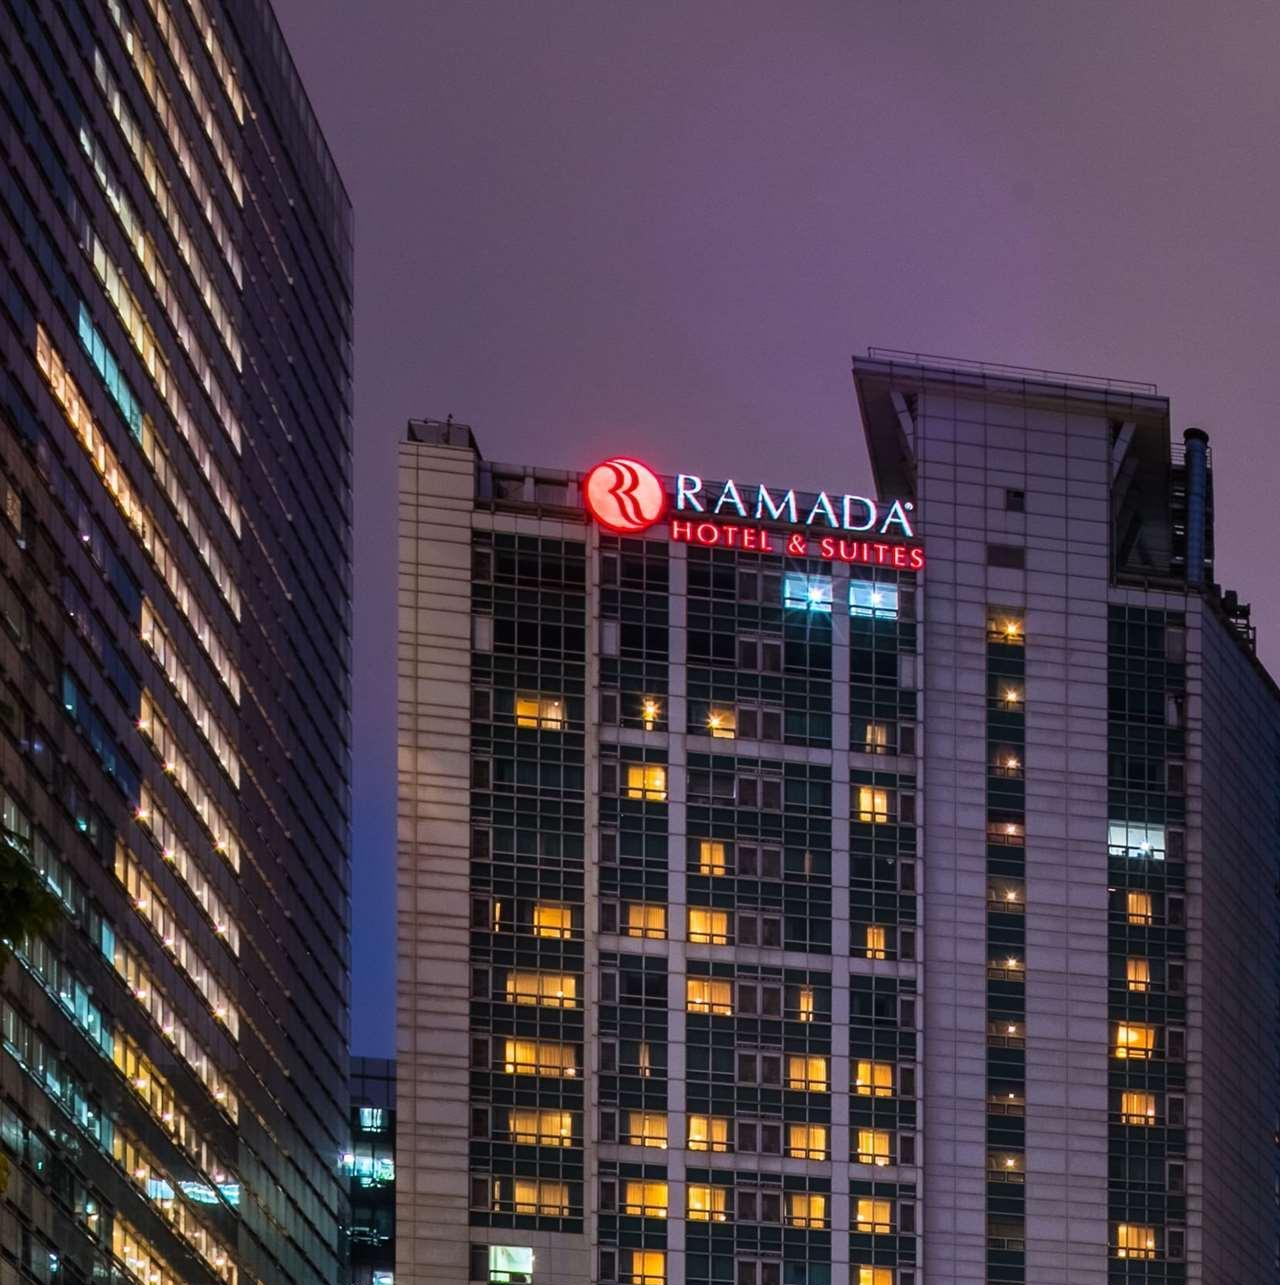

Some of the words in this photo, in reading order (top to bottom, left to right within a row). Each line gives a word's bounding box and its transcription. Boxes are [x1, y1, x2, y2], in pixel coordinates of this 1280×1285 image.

[676, 474, 914, 537] RAMADA
[672, 521, 774, 553] HOTEL
[787, 534, 807, 555] &
[821, 537, 926, 569] SUITES
